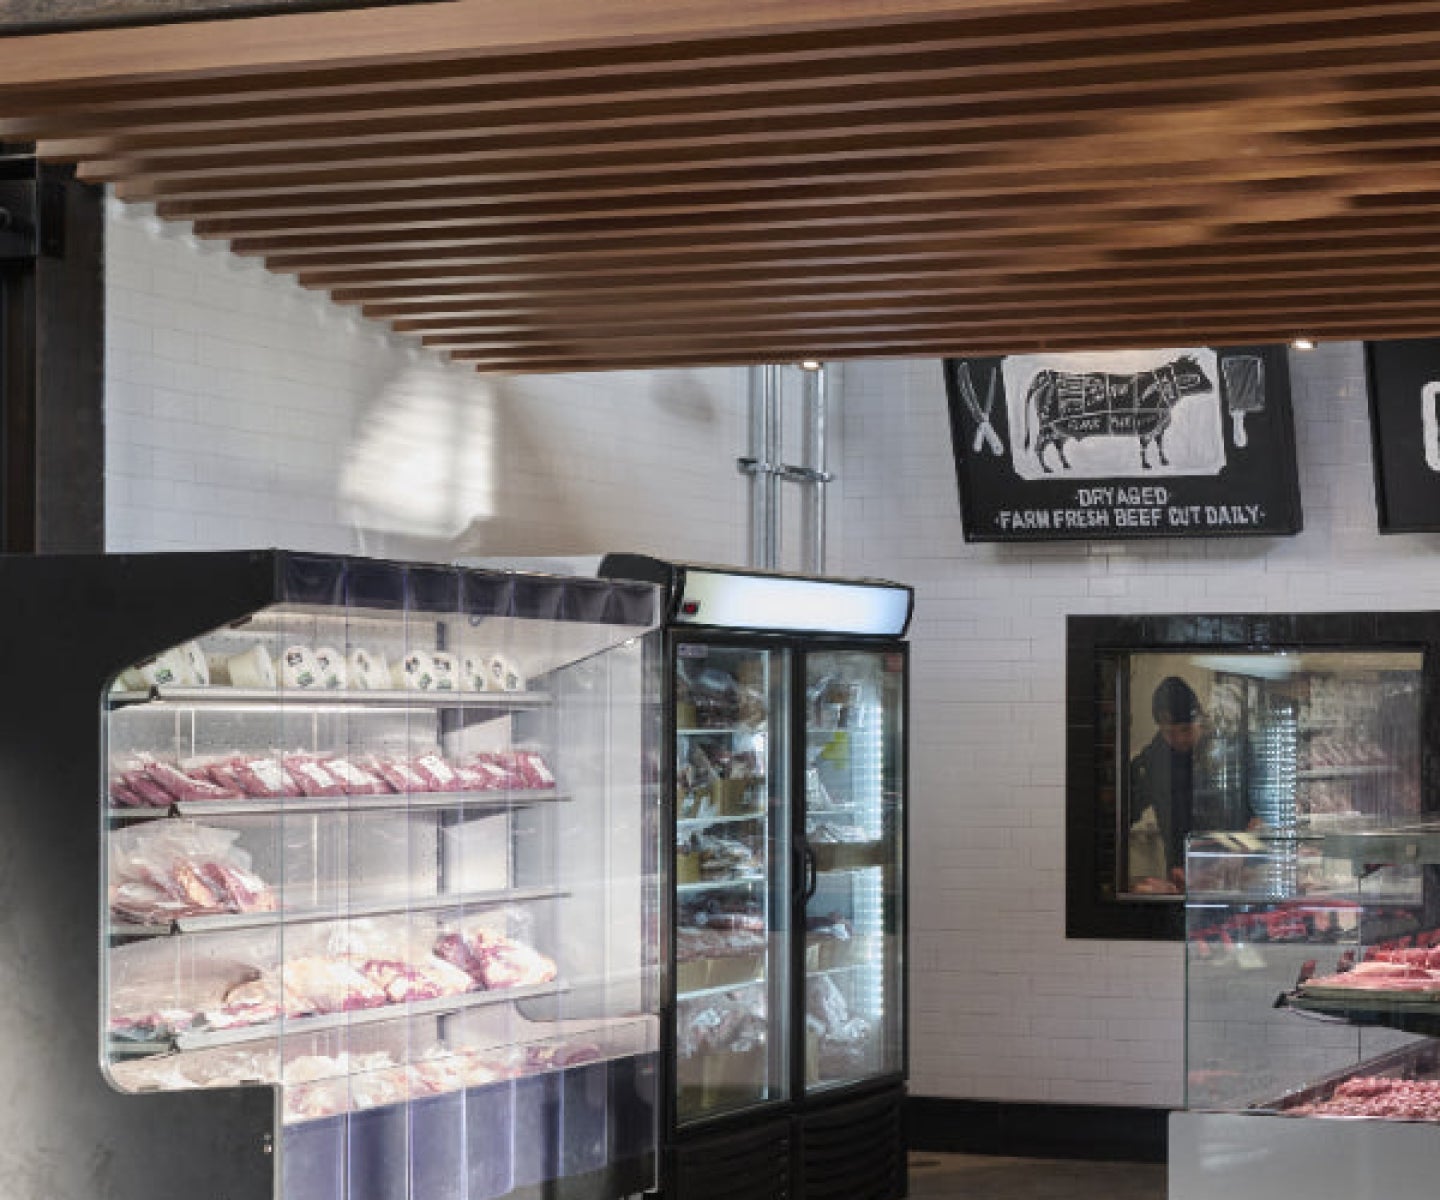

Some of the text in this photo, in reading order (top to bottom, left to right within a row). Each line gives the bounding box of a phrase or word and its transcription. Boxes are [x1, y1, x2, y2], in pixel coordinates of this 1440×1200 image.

[1078, 486, 1167, 507] DRY AGED
[1000, 504, 1259, 529] FARM FRESH BEEF CUT DAILY
